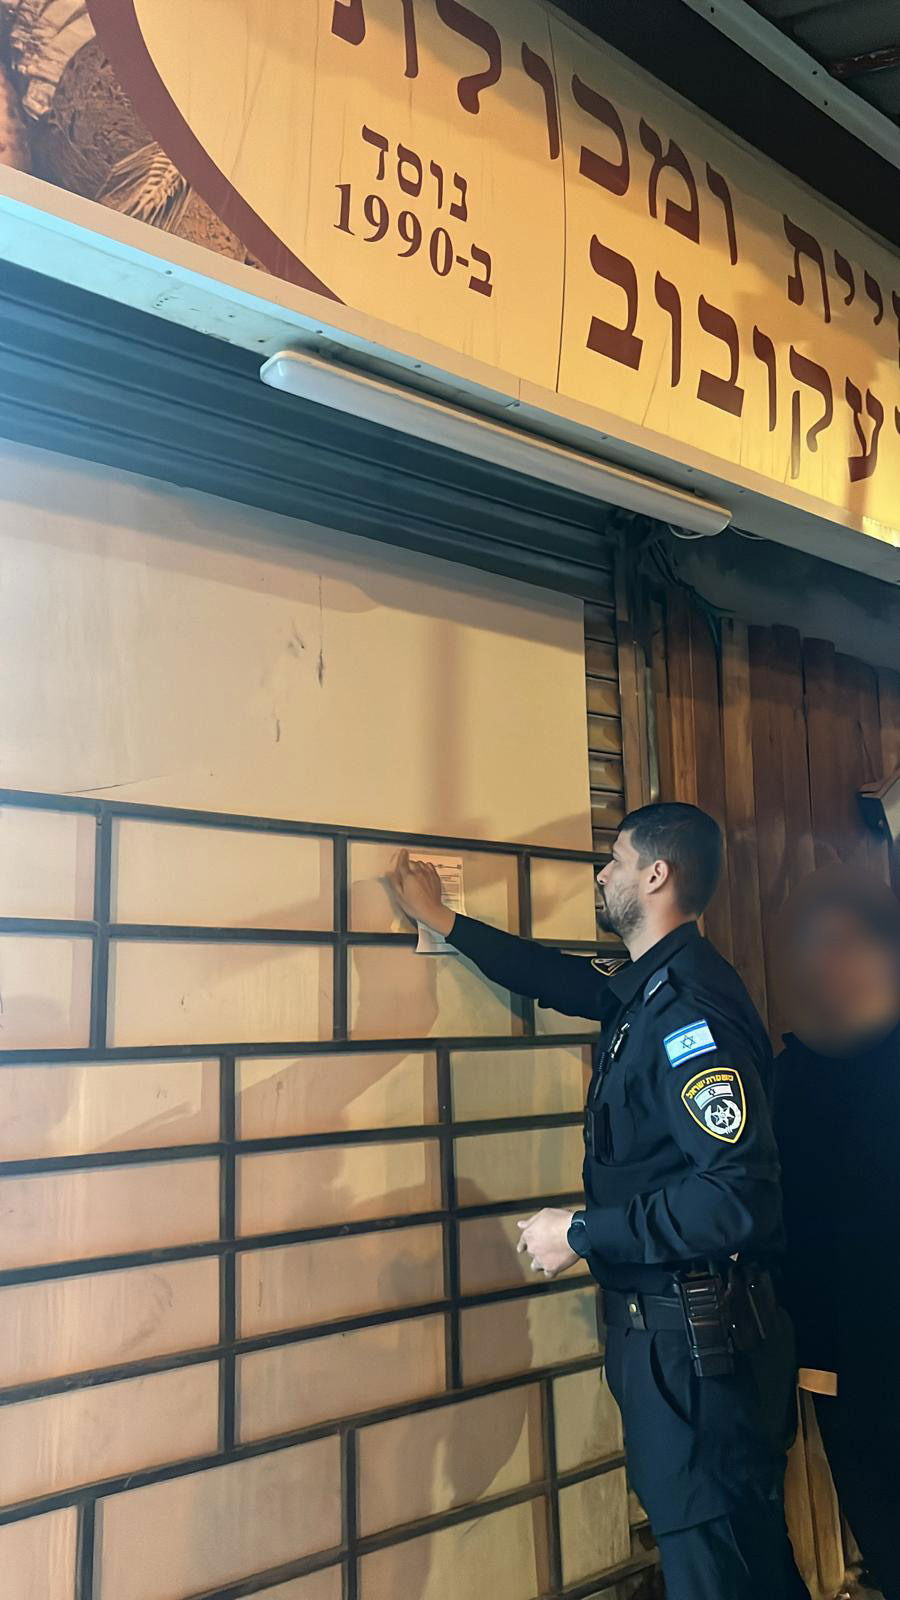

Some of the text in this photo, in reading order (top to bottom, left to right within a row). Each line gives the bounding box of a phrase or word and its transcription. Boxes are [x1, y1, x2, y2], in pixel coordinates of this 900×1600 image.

[333, 183, 493, 298] ב-1990
[361, 124, 468, 223] נוסד
[586, 233, 900, 483] עקובוב
[783, 213, 900, 369] יית
